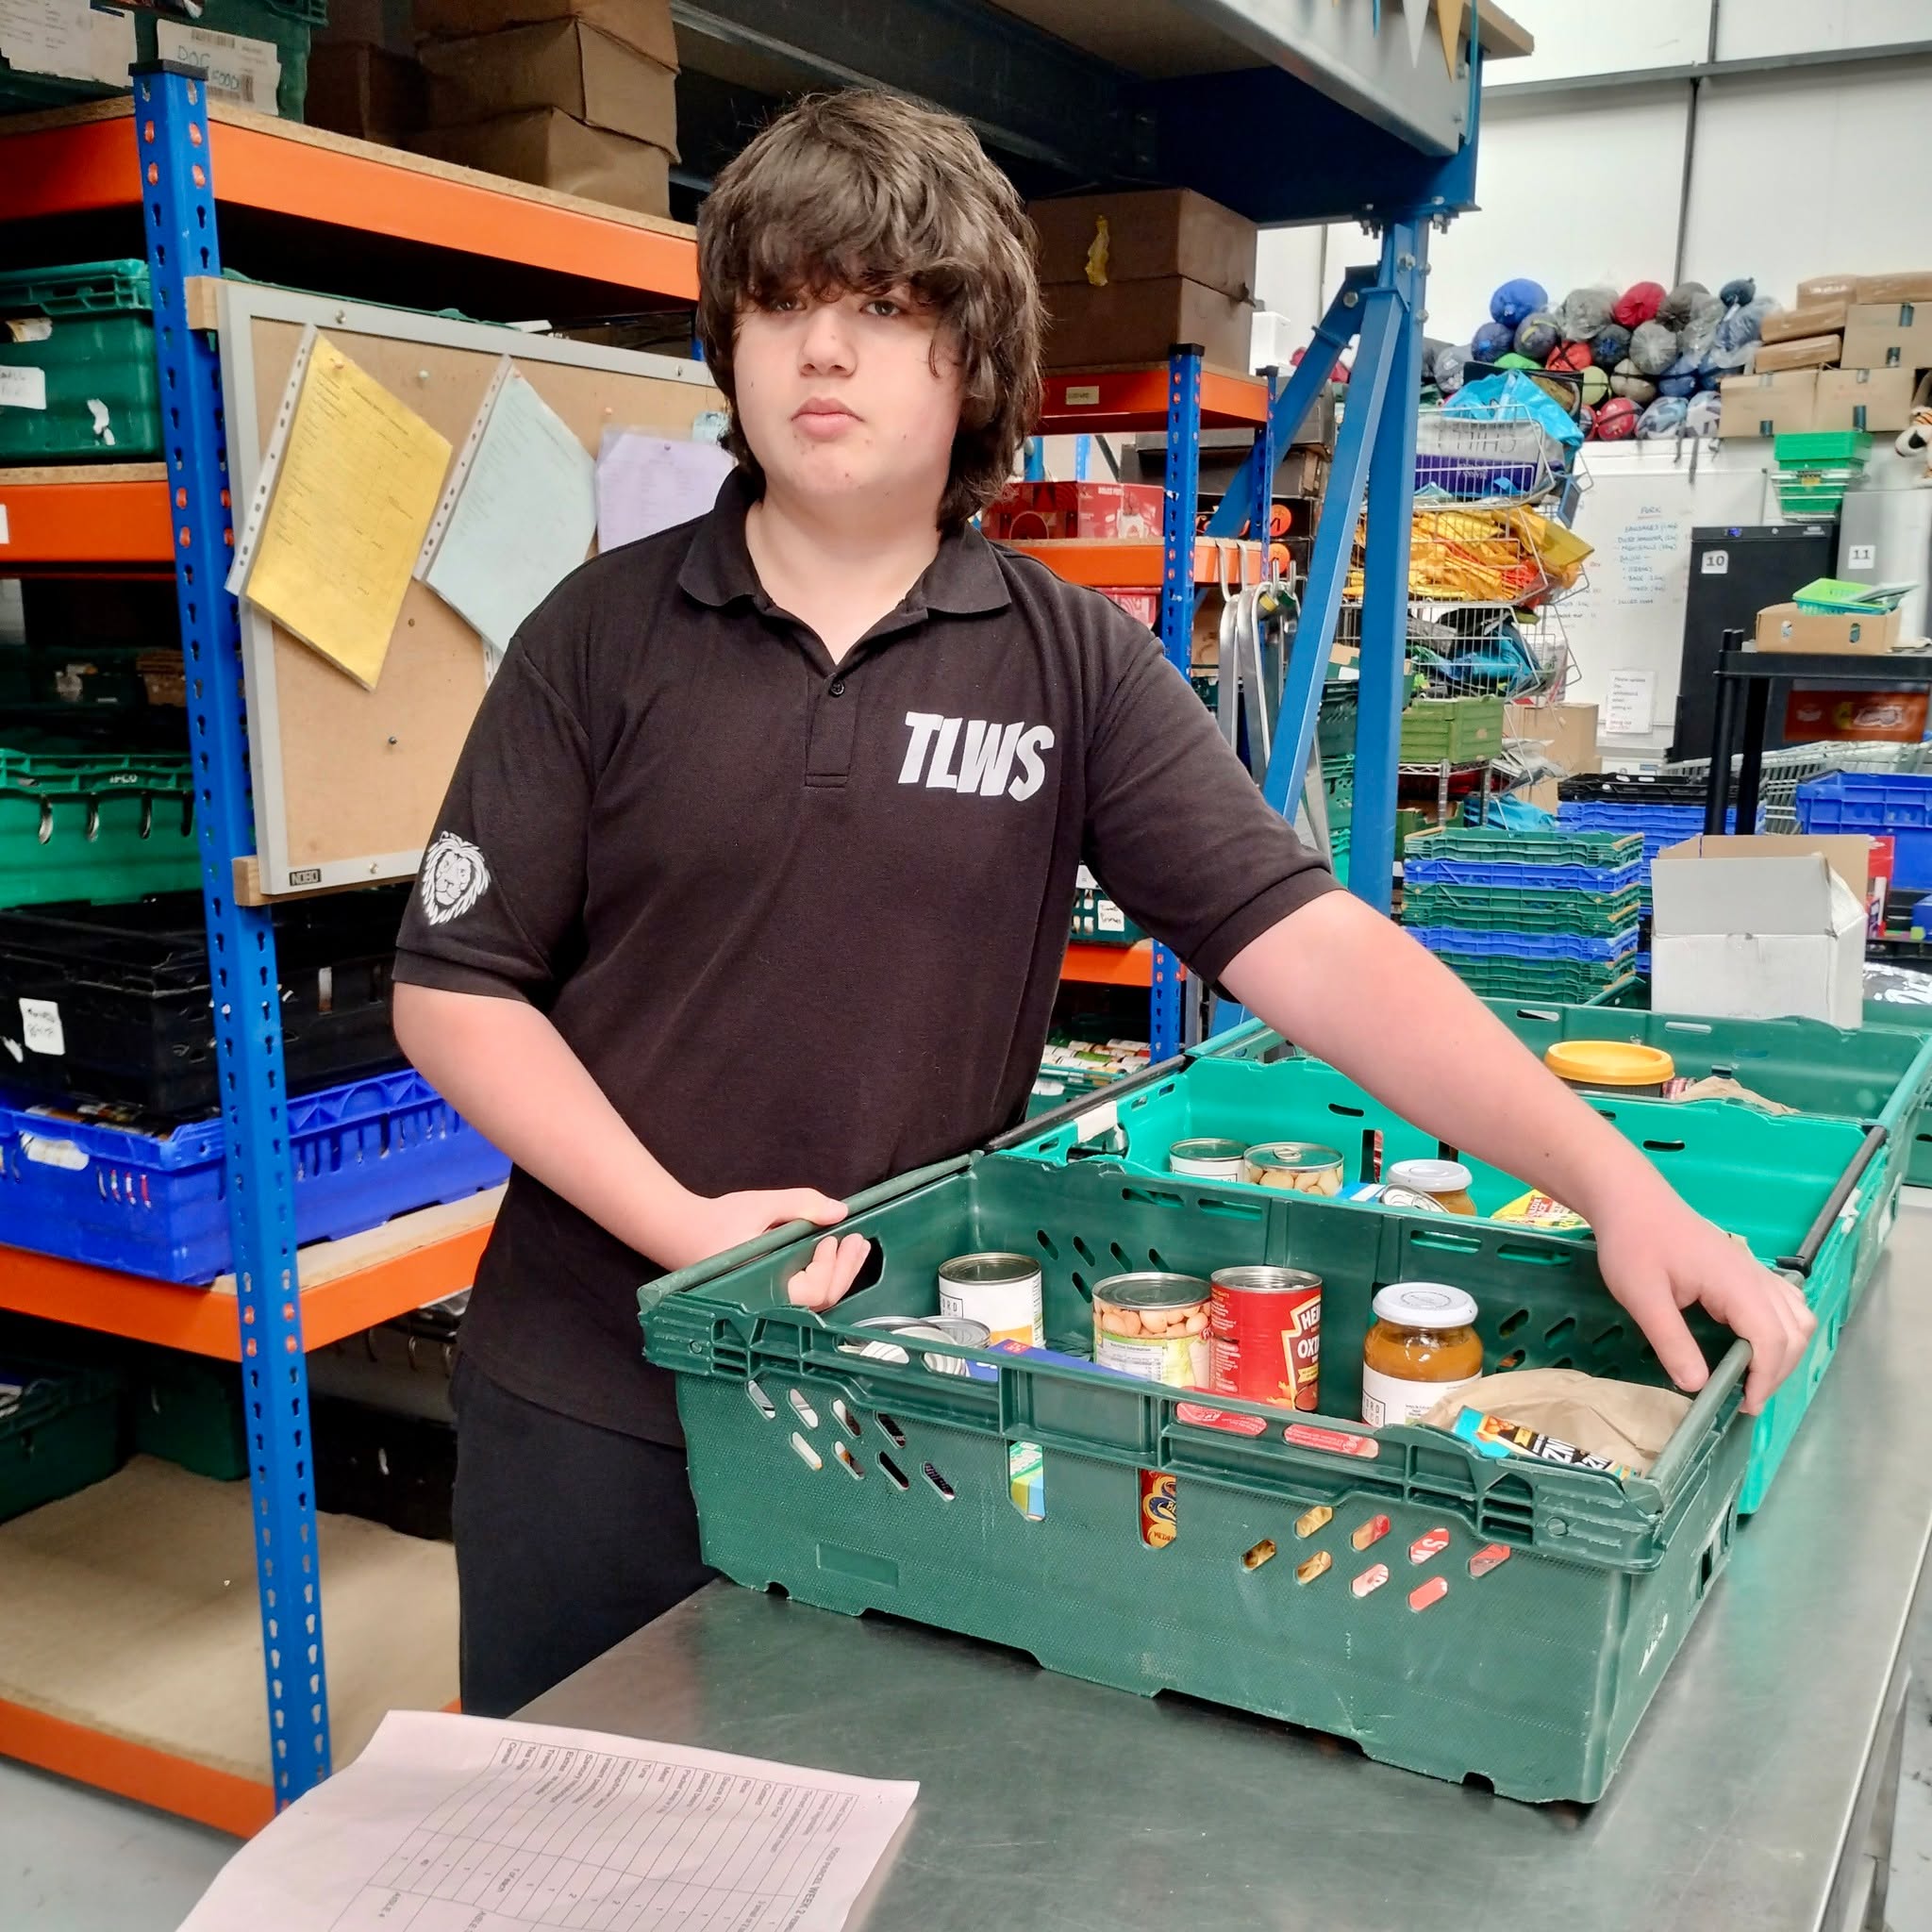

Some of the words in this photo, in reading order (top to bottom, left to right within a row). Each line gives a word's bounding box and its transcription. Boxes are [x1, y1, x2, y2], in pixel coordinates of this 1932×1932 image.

[1706, 555, 1725, 567] 10
[1852, 549, 1871, 560] 11
[897, 710, 1056, 802] TLWS
[291, 871, 320, 886] NOBO
[801, 1886, 819, 1907] WEEK
